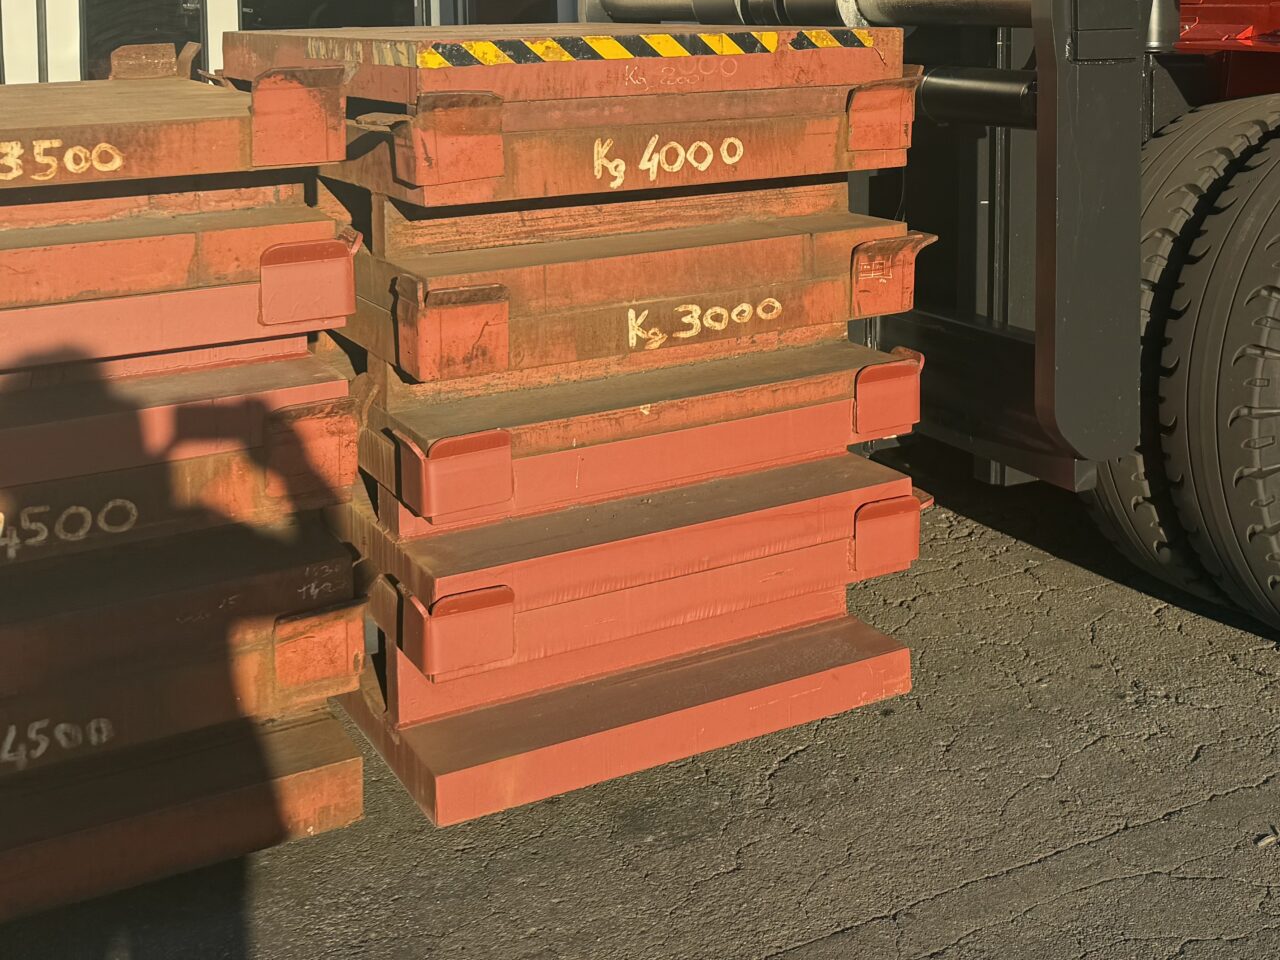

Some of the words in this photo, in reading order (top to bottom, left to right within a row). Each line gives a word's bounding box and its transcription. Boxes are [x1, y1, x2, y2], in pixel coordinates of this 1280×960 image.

[0, 139, 126, 180] 3500
[594, 138, 626, 189] Kg
[638, 134, 744, 181] 4000
[628, 308, 668, 350] Kg
[672, 297, 783, 338] 3000
[0, 718, 114, 771] 4500
